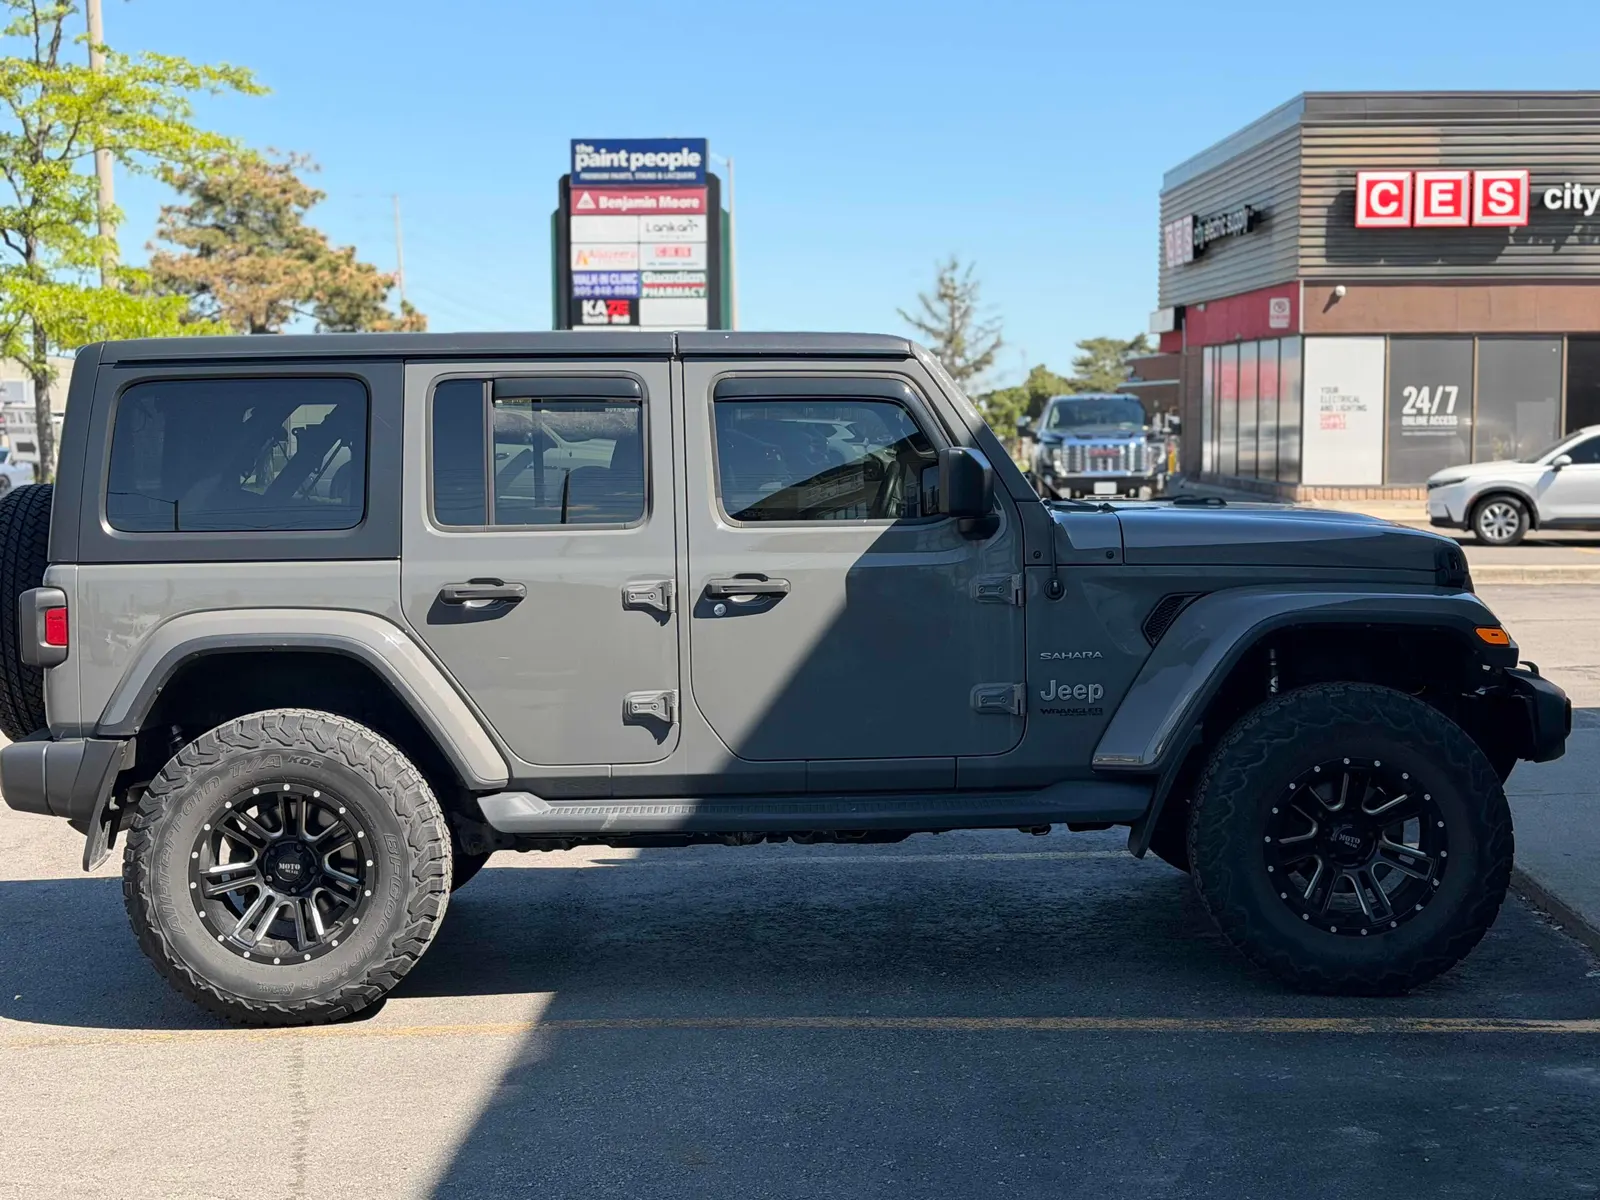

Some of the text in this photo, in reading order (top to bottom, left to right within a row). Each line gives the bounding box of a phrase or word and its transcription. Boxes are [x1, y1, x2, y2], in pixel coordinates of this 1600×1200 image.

[575, 144, 594, 153] the
[575, 147, 701, 172] paint people
[599, 196, 699, 211] Benjamin Moore
[1367, 179, 1600, 217] CES city
[642, 286, 706, 298] PHARMACY
[582, 299, 630, 316] KAZE
[1402, 385, 1458, 414] 24/7
[1429, 415, 1458, 426] ACCESS
[1039, 651, 1103, 660] SAHARA
[1040, 679, 1104, 704] Jeep
[1040, 707, 1103, 715] WRANGLER
[229, 754, 282, 779] T/A
[1338, 833, 1361, 845] MOTO
[278, 862, 301, 871] MOTO
